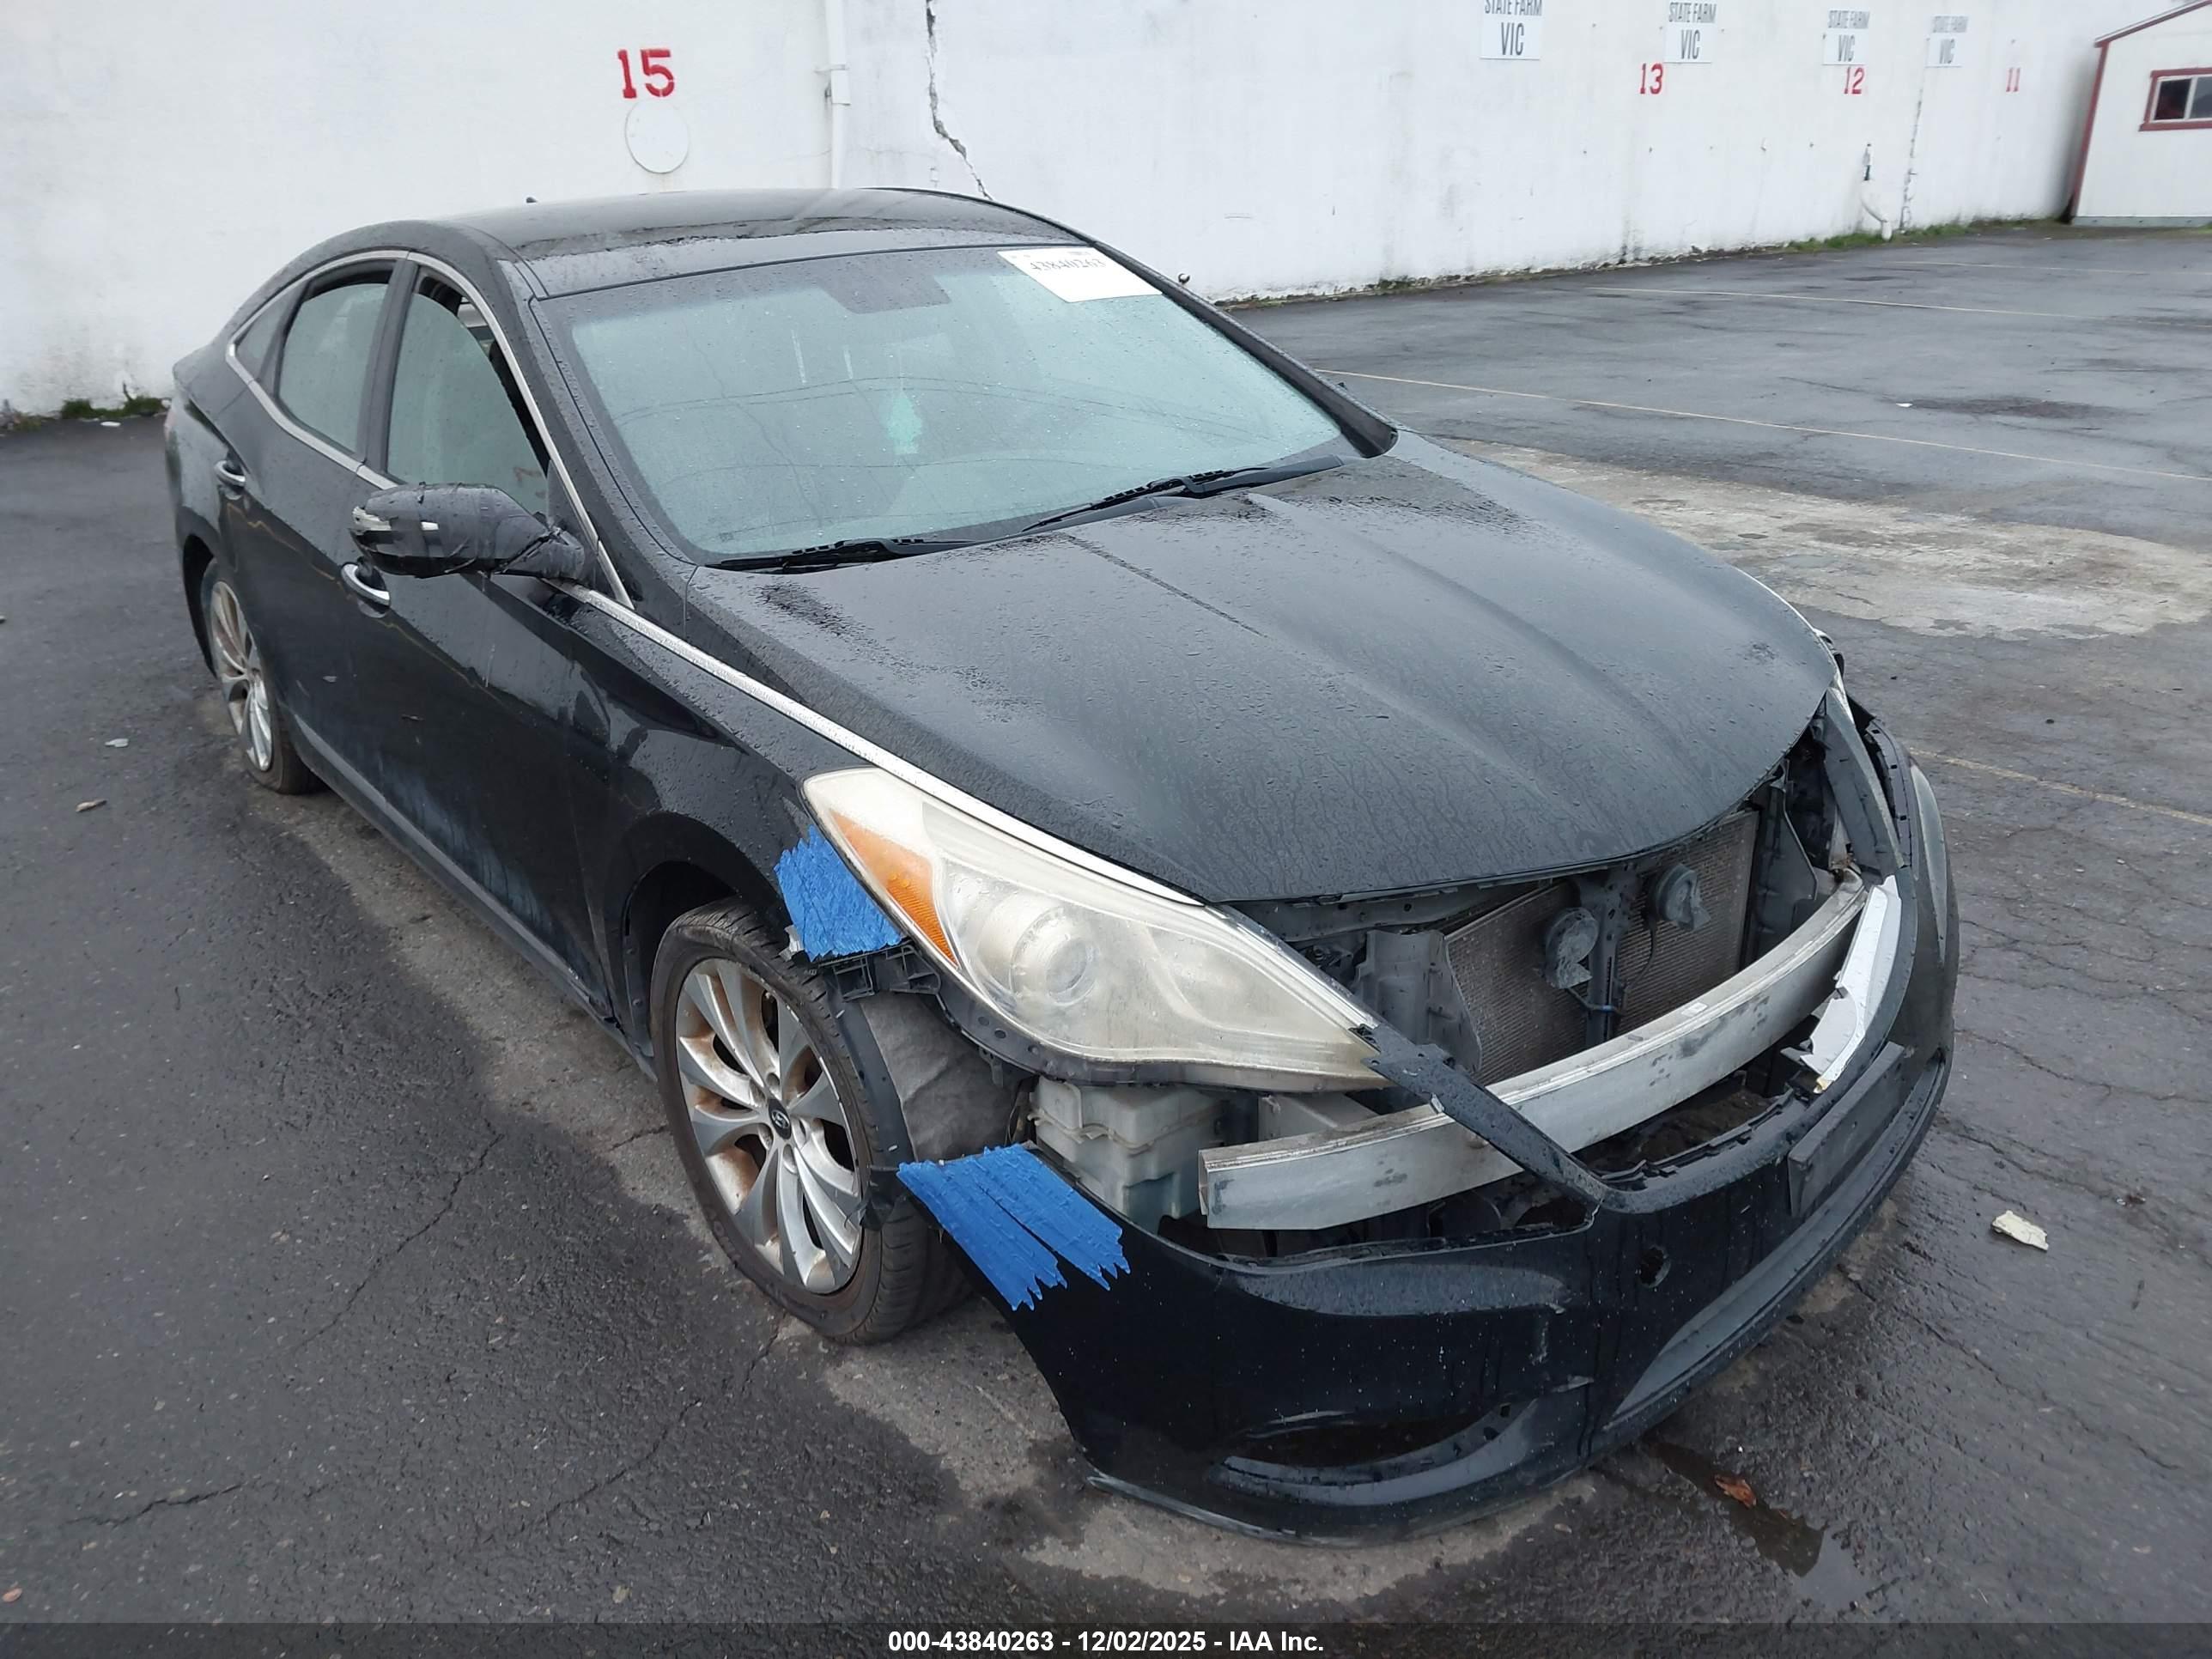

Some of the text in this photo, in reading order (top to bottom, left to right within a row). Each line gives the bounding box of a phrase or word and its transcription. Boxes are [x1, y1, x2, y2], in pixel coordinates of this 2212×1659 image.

[1485, 0, 1542, 17] STATE FARM
[1501, 22, 1524, 56] VIC
[1680, 29, 1700, 59] VIC
[617, 49, 675, 99] 15
[1640, 63, 1663, 94] 13
[1844, 67, 1864, 94] 12
[2006, 68, 2020, 92] 11
